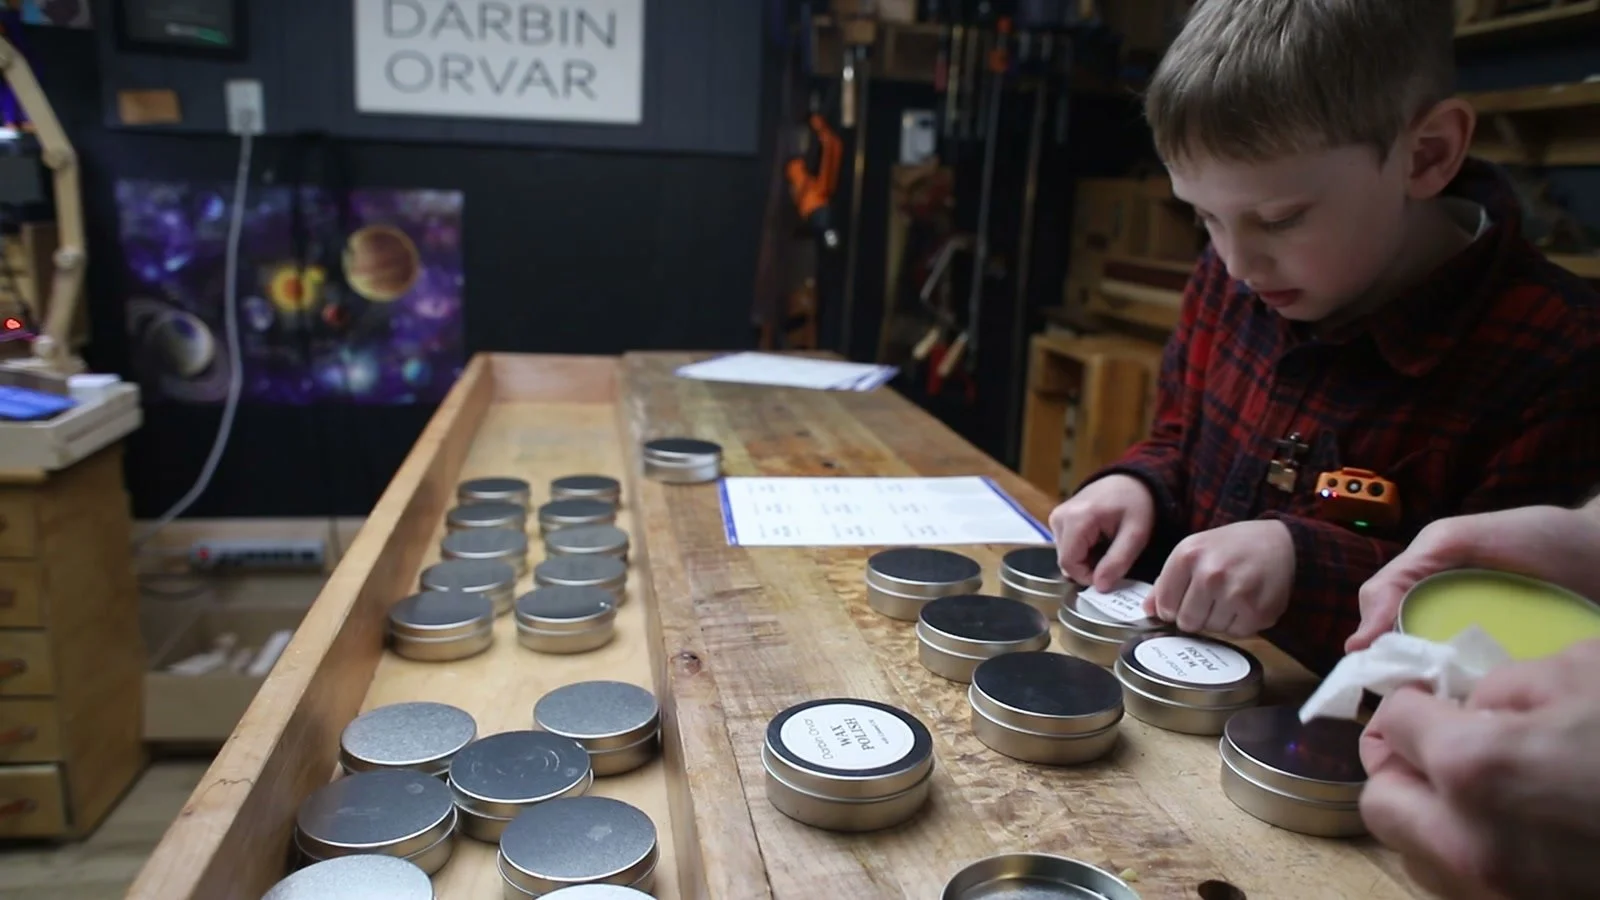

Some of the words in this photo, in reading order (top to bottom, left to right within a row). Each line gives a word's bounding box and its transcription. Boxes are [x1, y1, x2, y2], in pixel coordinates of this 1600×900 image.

[383, 0, 616, 48] DARBIN
[384, 49, 597, 100] ORVAR
[1177, 651, 1197, 668] WAX
[1185, 646, 1219, 672] POLISH
[830, 724, 852, 747] WAX
[844, 716, 875, 751] POLISH
